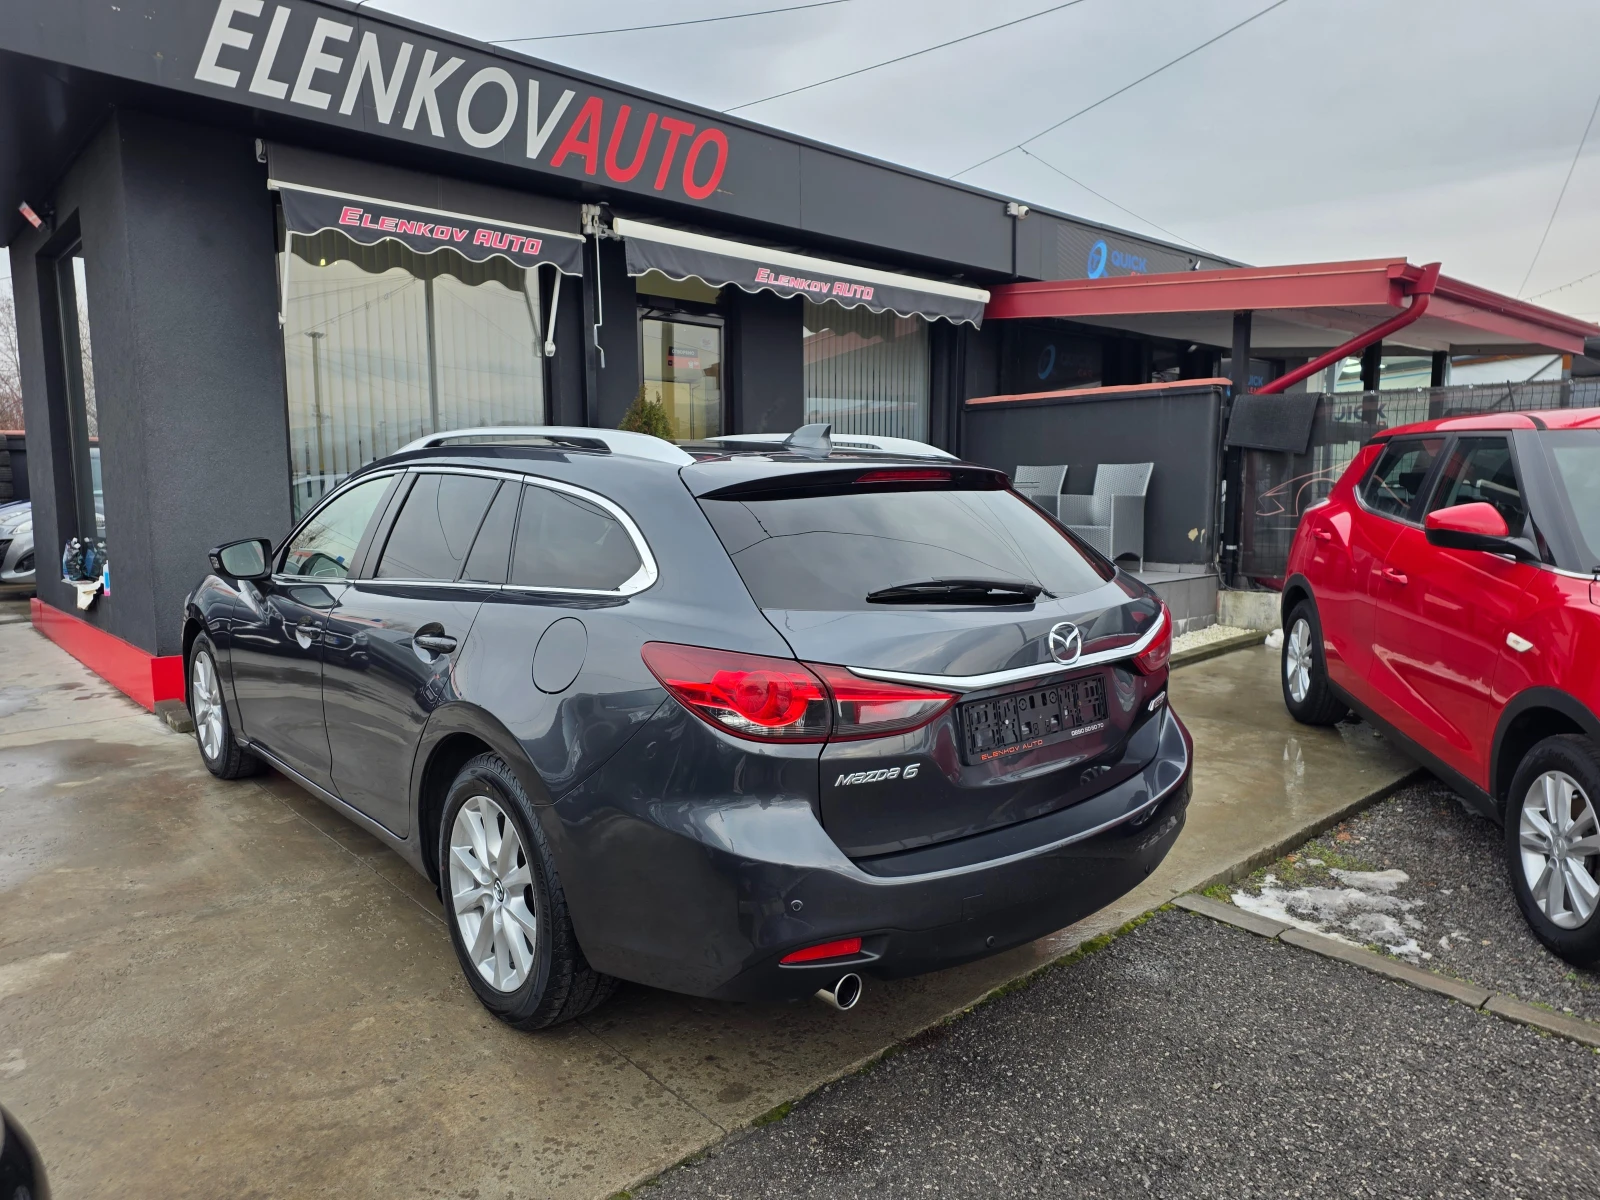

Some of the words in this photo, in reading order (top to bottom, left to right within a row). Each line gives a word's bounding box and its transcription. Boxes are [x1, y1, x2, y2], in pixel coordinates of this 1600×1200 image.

[338, 206, 469, 242] ELENKOV
[473, 228, 543, 256] AUTO
[1111, 250, 1147, 273] QUICK
[754, 268, 831, 293] ELENKOV
[832, 281, 874, 300] AUTO
[1022, 739, 1043, 750] AUTO
[902, 763, 921, 780] 6
